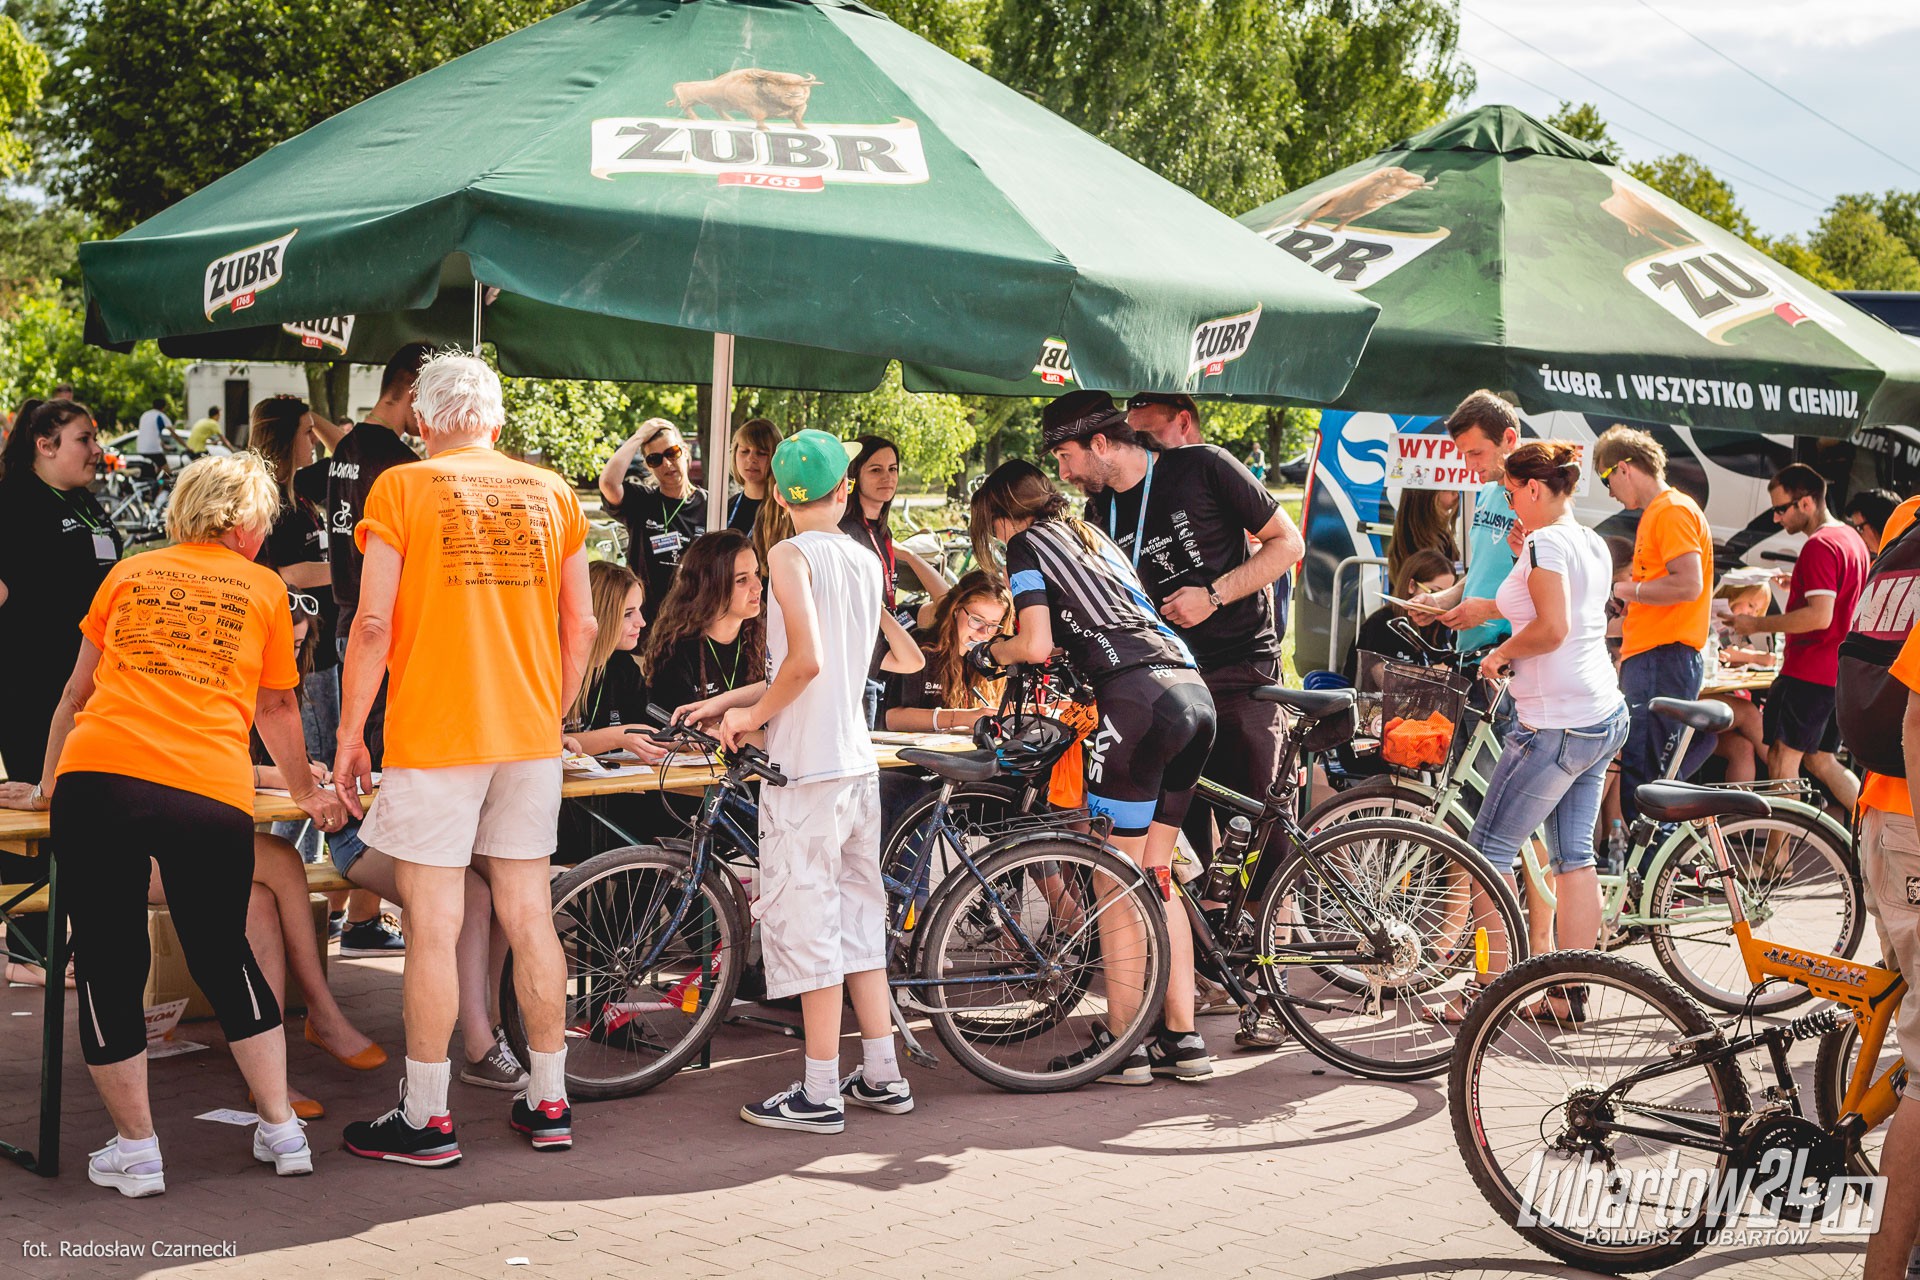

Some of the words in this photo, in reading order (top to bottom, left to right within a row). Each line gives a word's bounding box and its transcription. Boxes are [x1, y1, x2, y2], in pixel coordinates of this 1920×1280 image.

[616, 121, 909, 174] ŻUBR
[742, 174, 801, 189] 1768
[210, 245, 280, 303] ŻUBR
[236, 295, 251, 307] 1768
[1196, 320, 1251, 361] ŻUBR
[1539, 363, 1612, 399] ŻUBR.
[1617, 374, 1627, 399] I
[1630, 374, 1754, 410] WSZYSTKO
[1759, 384, 1781, 411] W
[1788, 386, 1859, 419] CIENIU.
[461, 474, 503, 484] ŚWIĘTO
[506, 478, 547, 488] ROWERU
[145, 568, 197, 580] ŚWIĘTO
[201, 575, 251, 590] ROWERU
[465, 578, 531, 588] swietoroweru.pl
[220, 602, 246, 615] wibro
[216, 617, 244, 632] PEGWAN
[1105, 648, 1121, 666] FOX
[130, 664, 210, 685] swietoroweru.pl
